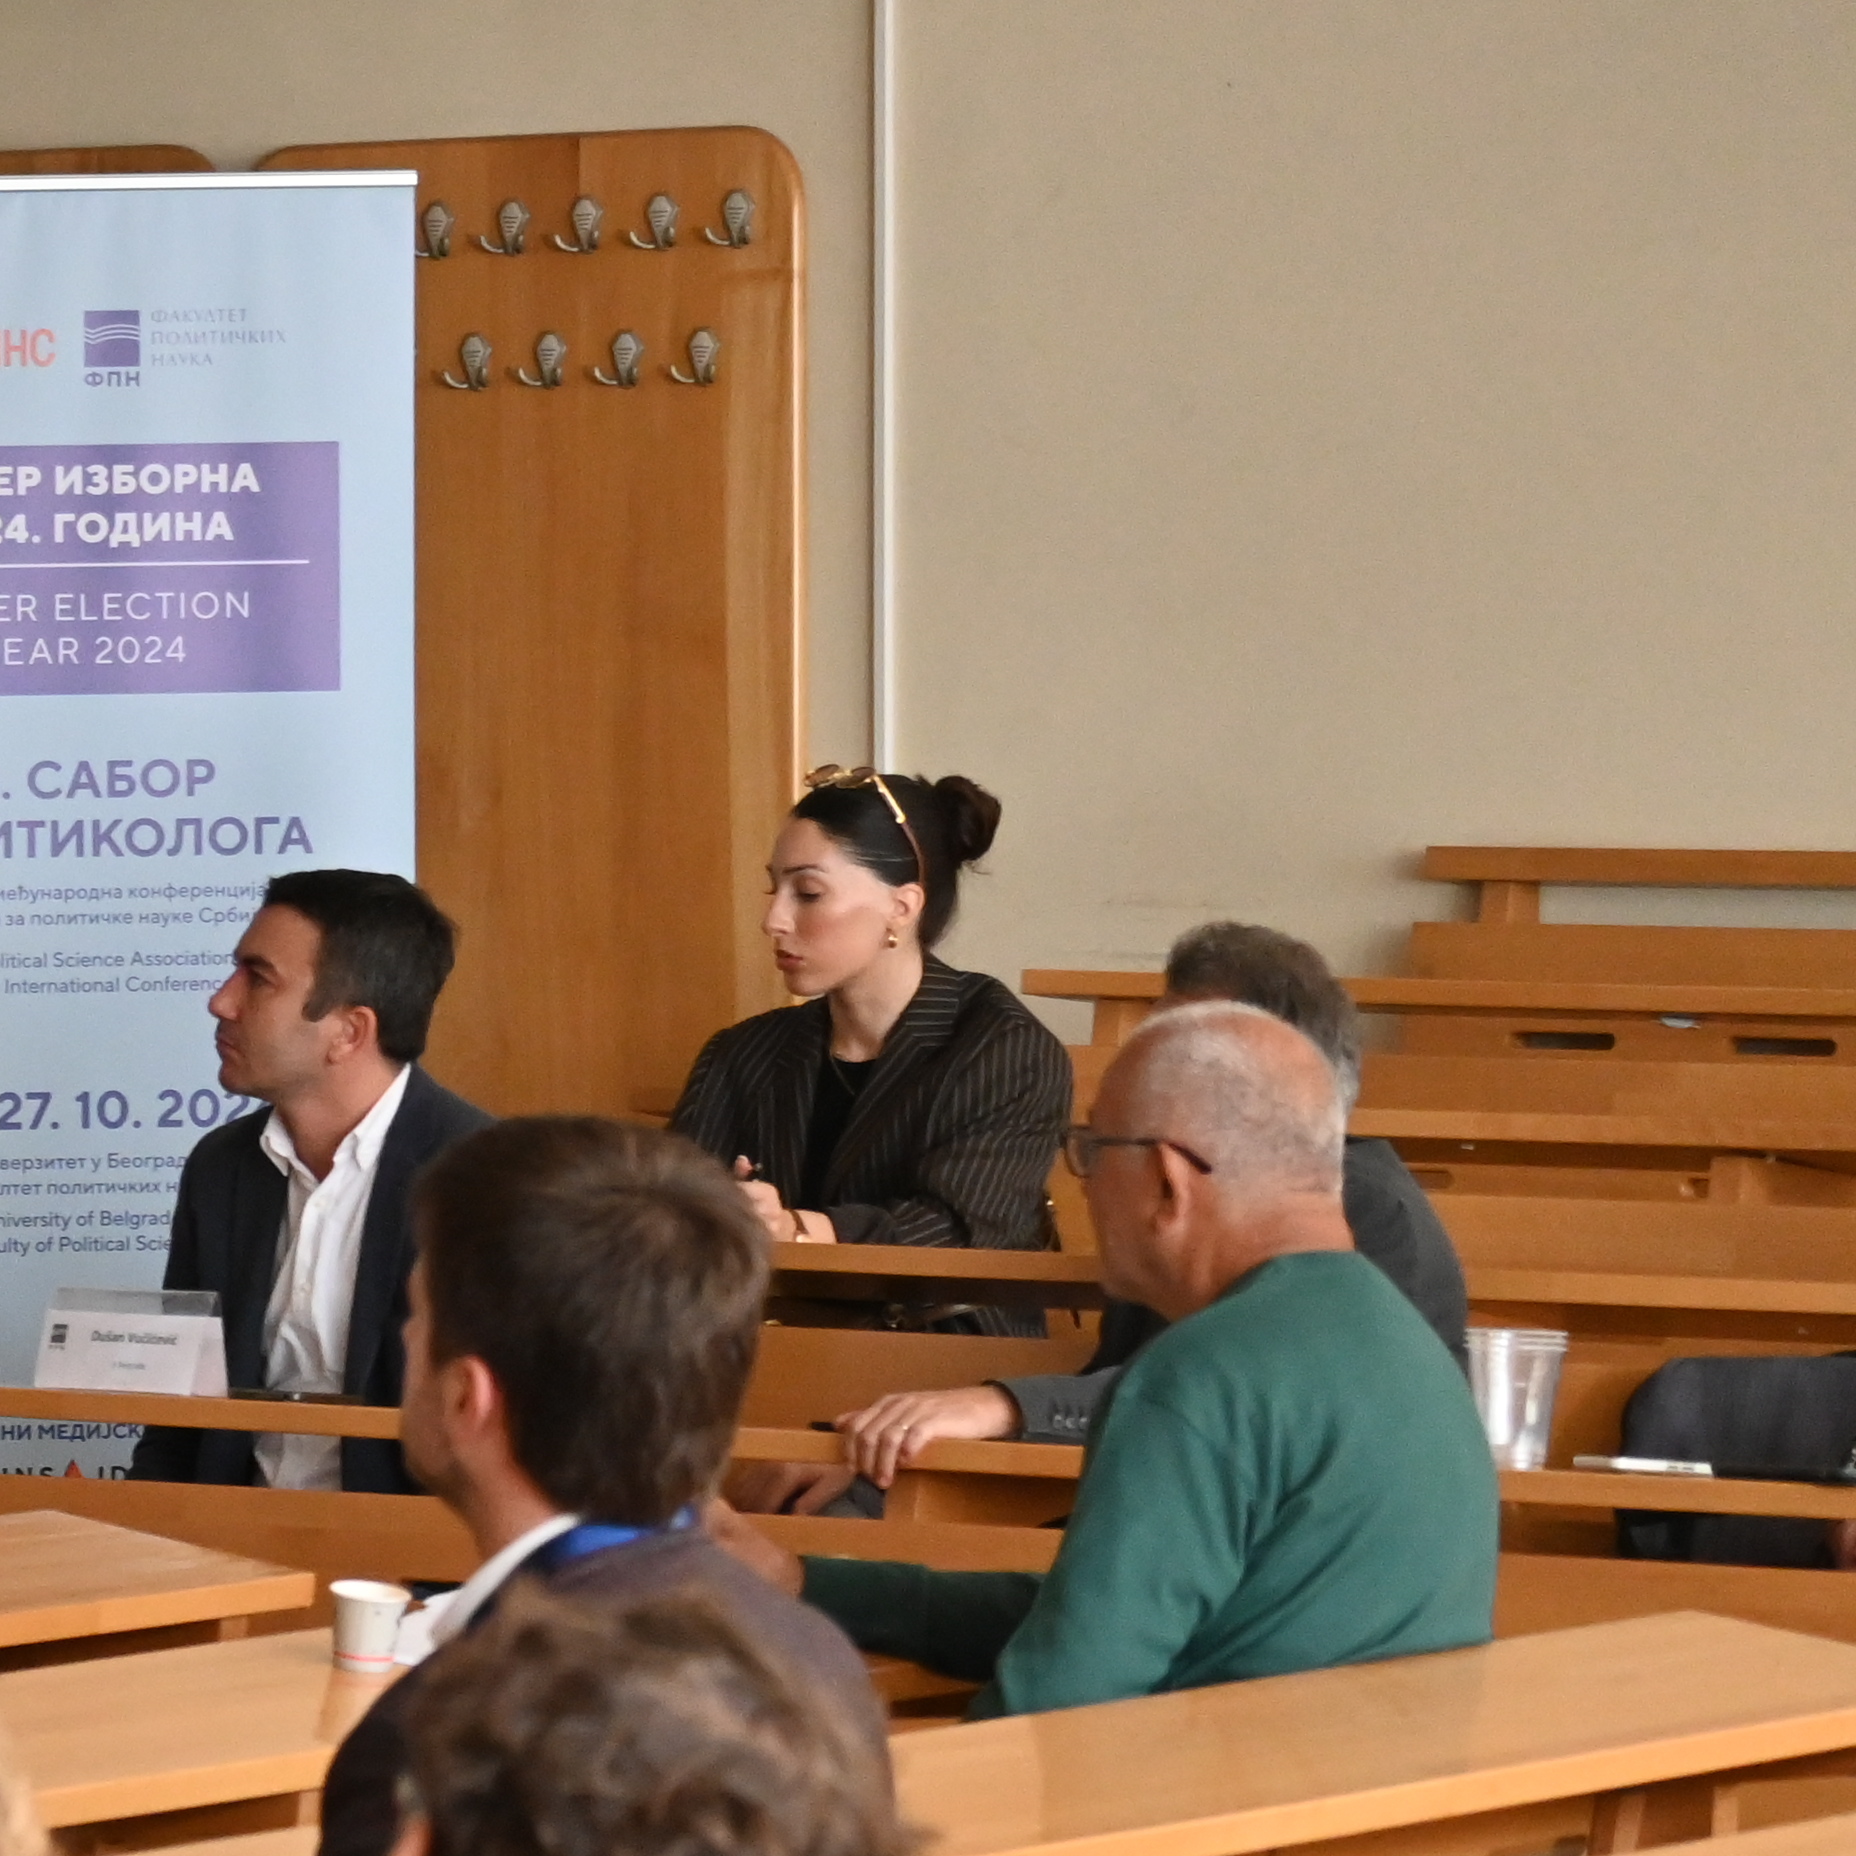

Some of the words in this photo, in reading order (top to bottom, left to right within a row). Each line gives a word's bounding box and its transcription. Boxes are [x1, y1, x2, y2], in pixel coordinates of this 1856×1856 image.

[84, 371, 141, 388] ФПН
[54, 462, 260, 496] ИЗБОРНА
[53, 510, 235, 548] ГОДИНА
[54, 589, 252, 622] ELECTION
[94, 634, 188, 666] 2024
[26, 758, 217, 801] САБОР
[5, 914, 25, 926] за
[138, 910, 193, 928] науке
[53, 951, 125, 968] Science
[4, 975, 119, 994] International
[125, 975, 224, 992] Conferenc
[75, 1090, 141, 1130] 10.
[157, 1088, 265, 1129] 202
[90, 1155, 101, 1173] у
[107, 1153, 187, 1173] Београд
[47, 1180, 160, 1195] политичких
[75, 1211, 93, 1226] of
[100, 1210, 170, 1230] Belgrad
[35, 1236, 54, 1253] of
[59, 1235, 130, 1253] Political
[38, 1423, 142, 1442] МЕДИЈСК
